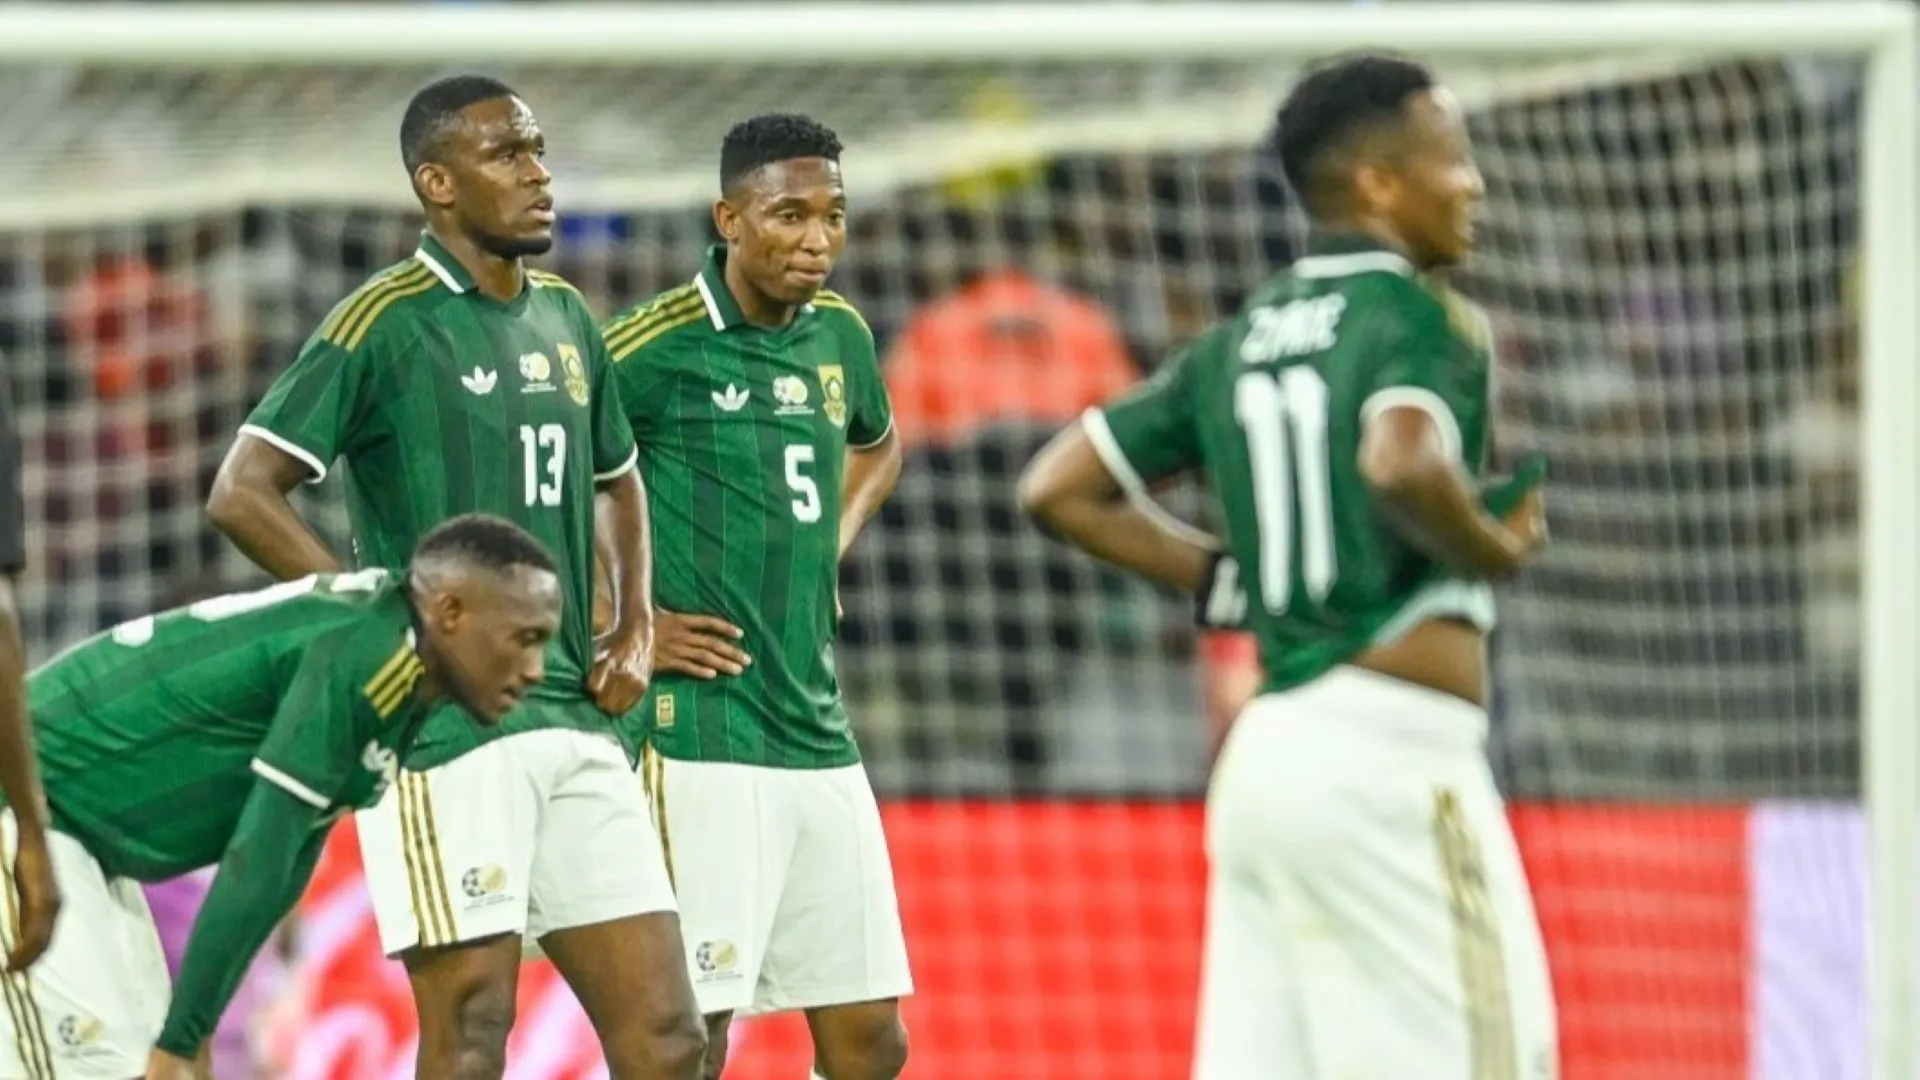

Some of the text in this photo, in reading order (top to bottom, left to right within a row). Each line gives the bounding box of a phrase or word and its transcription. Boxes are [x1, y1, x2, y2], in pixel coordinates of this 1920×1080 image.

[519, 423, 567, 507] 13
[784, 443, 823, 523] 5
[1234, 364, 1339, 616] 11
